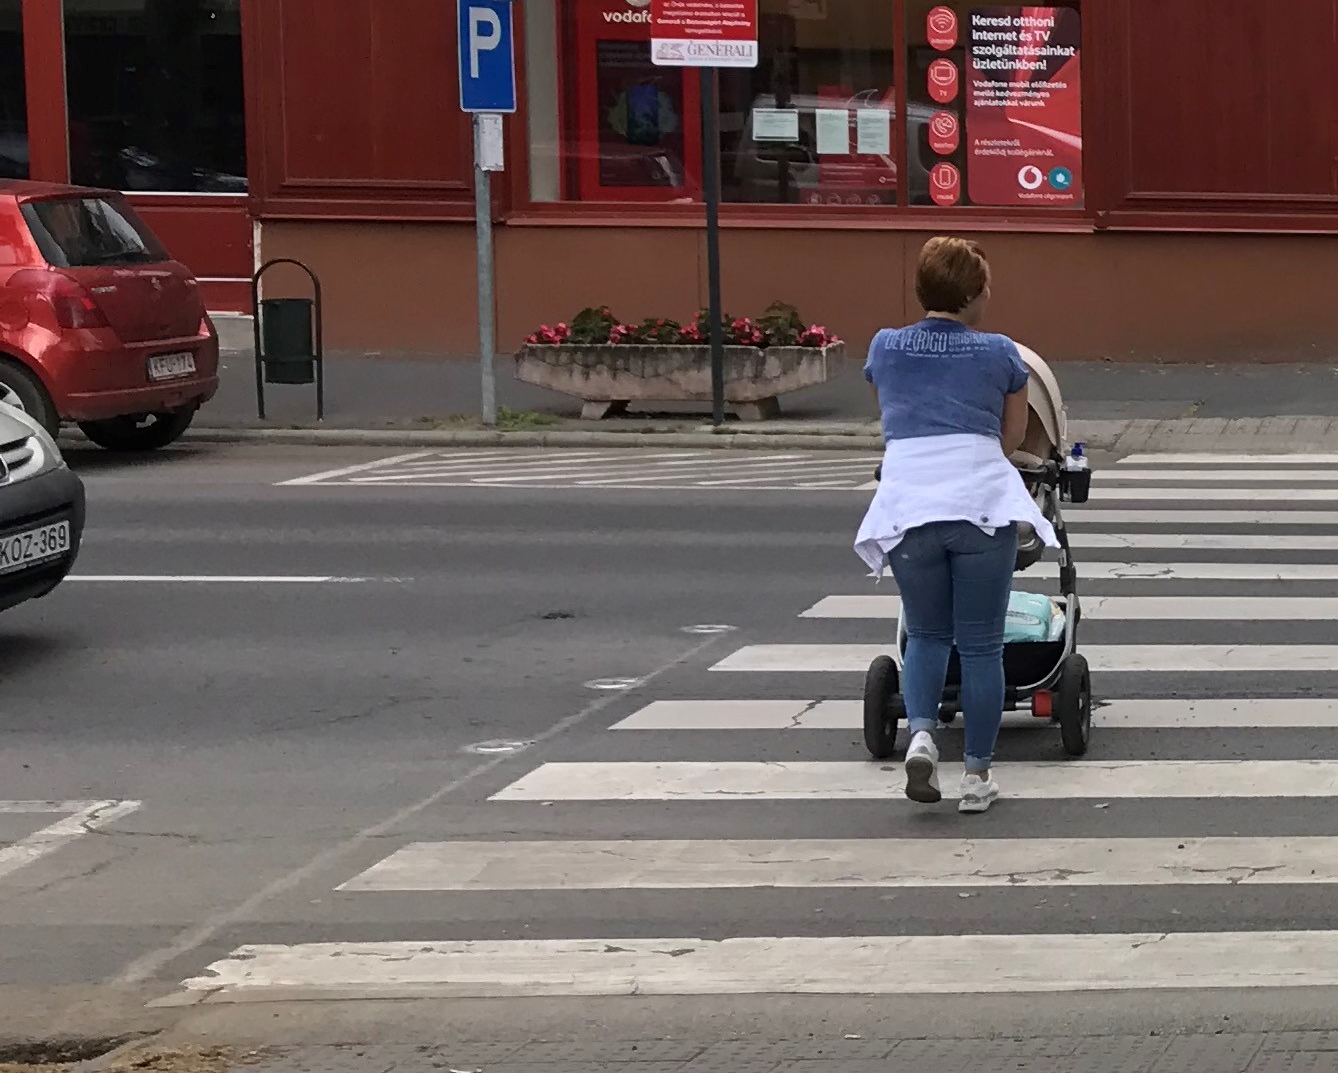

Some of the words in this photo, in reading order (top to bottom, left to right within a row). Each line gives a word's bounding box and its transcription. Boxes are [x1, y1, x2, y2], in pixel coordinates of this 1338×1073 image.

[972, 15, 1012, 27] Keresd
[1013, 16, 1055, 27] otthoni
[1018, 30, 1032, 41] és
[1034, 30, 1051, 41] TV
[469, 6, 501, 79] P
[687, 42, 753, 57] GENERALI
[972, 44, 1076, 57] szolgáltatásainkat
[972, 57, 1047, 70] üzletünkben!
[972, 80, 1008, 88] Vodafone
[0, 524, 66, 565] KOZ-369
